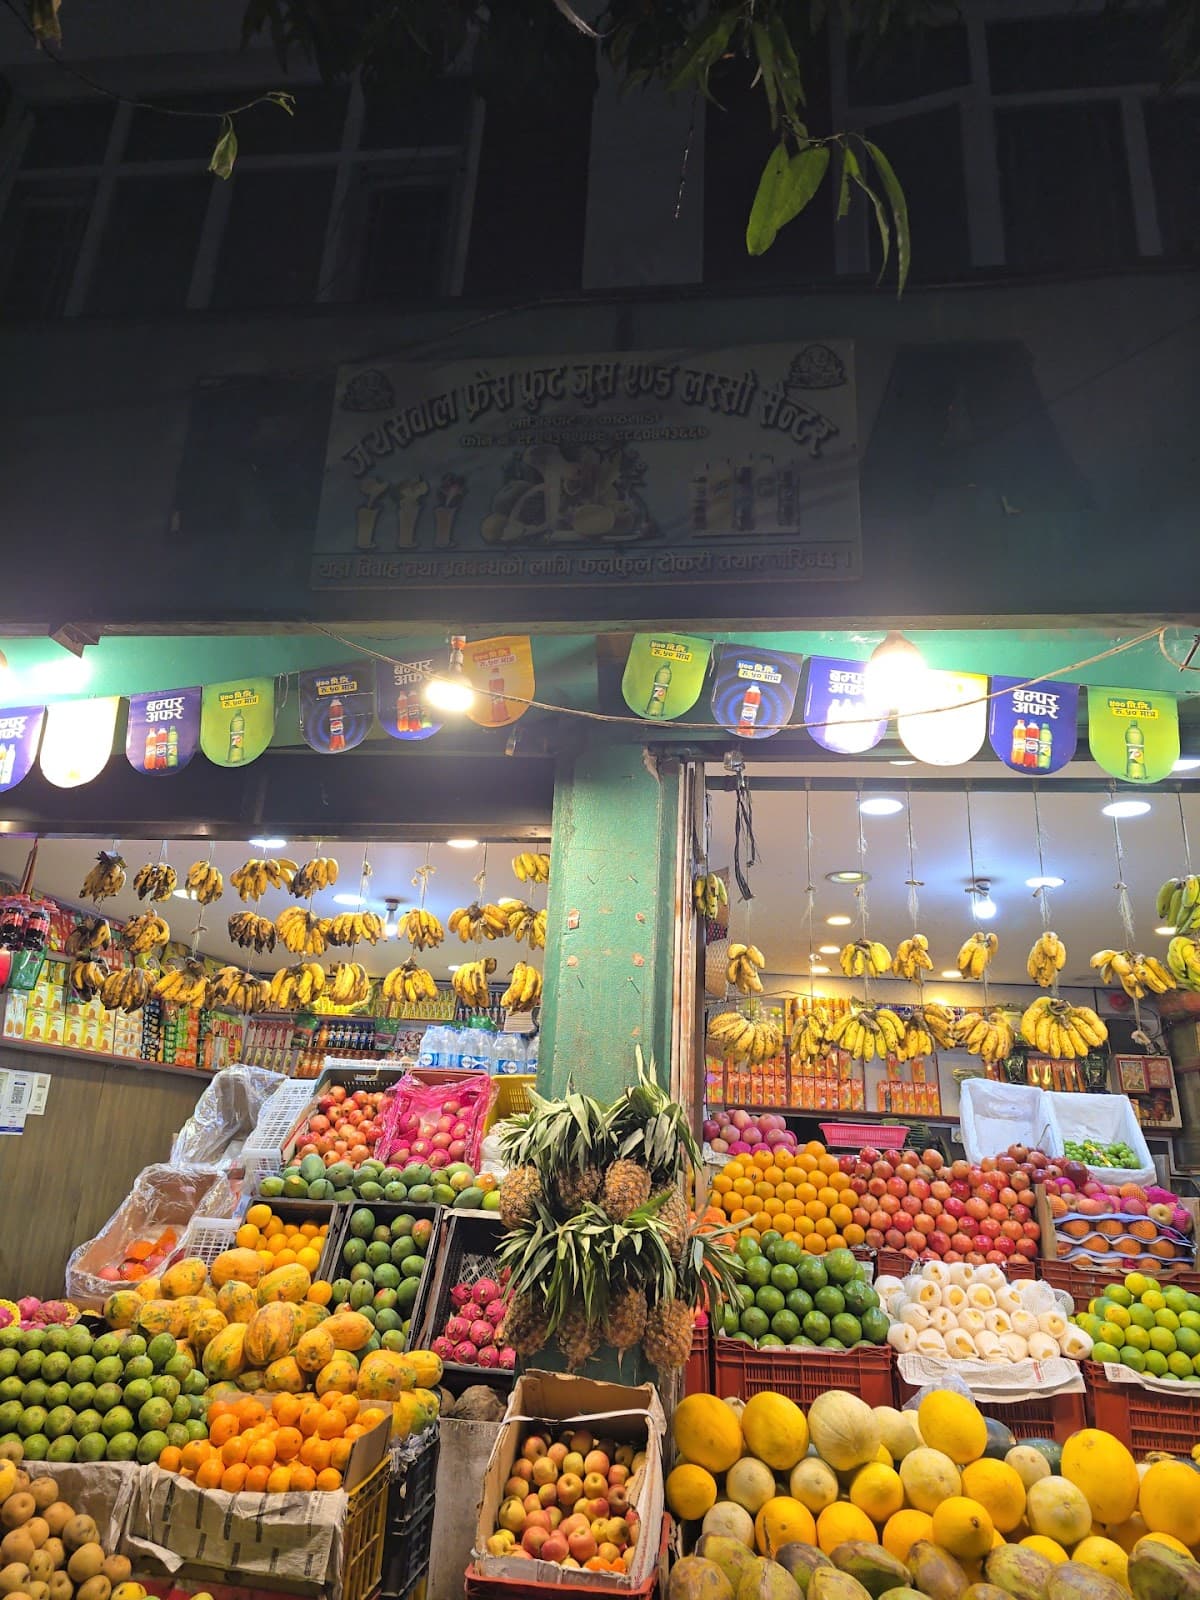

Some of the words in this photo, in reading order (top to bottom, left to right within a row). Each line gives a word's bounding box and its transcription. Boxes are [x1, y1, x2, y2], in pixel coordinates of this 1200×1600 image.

[145, 696, 185, 712] बम्पर
[1012, 689, 1060, 706] बम्पर
[145, 707, 184, 722] अफर
[1012, 700, 1060, 719] अफर
